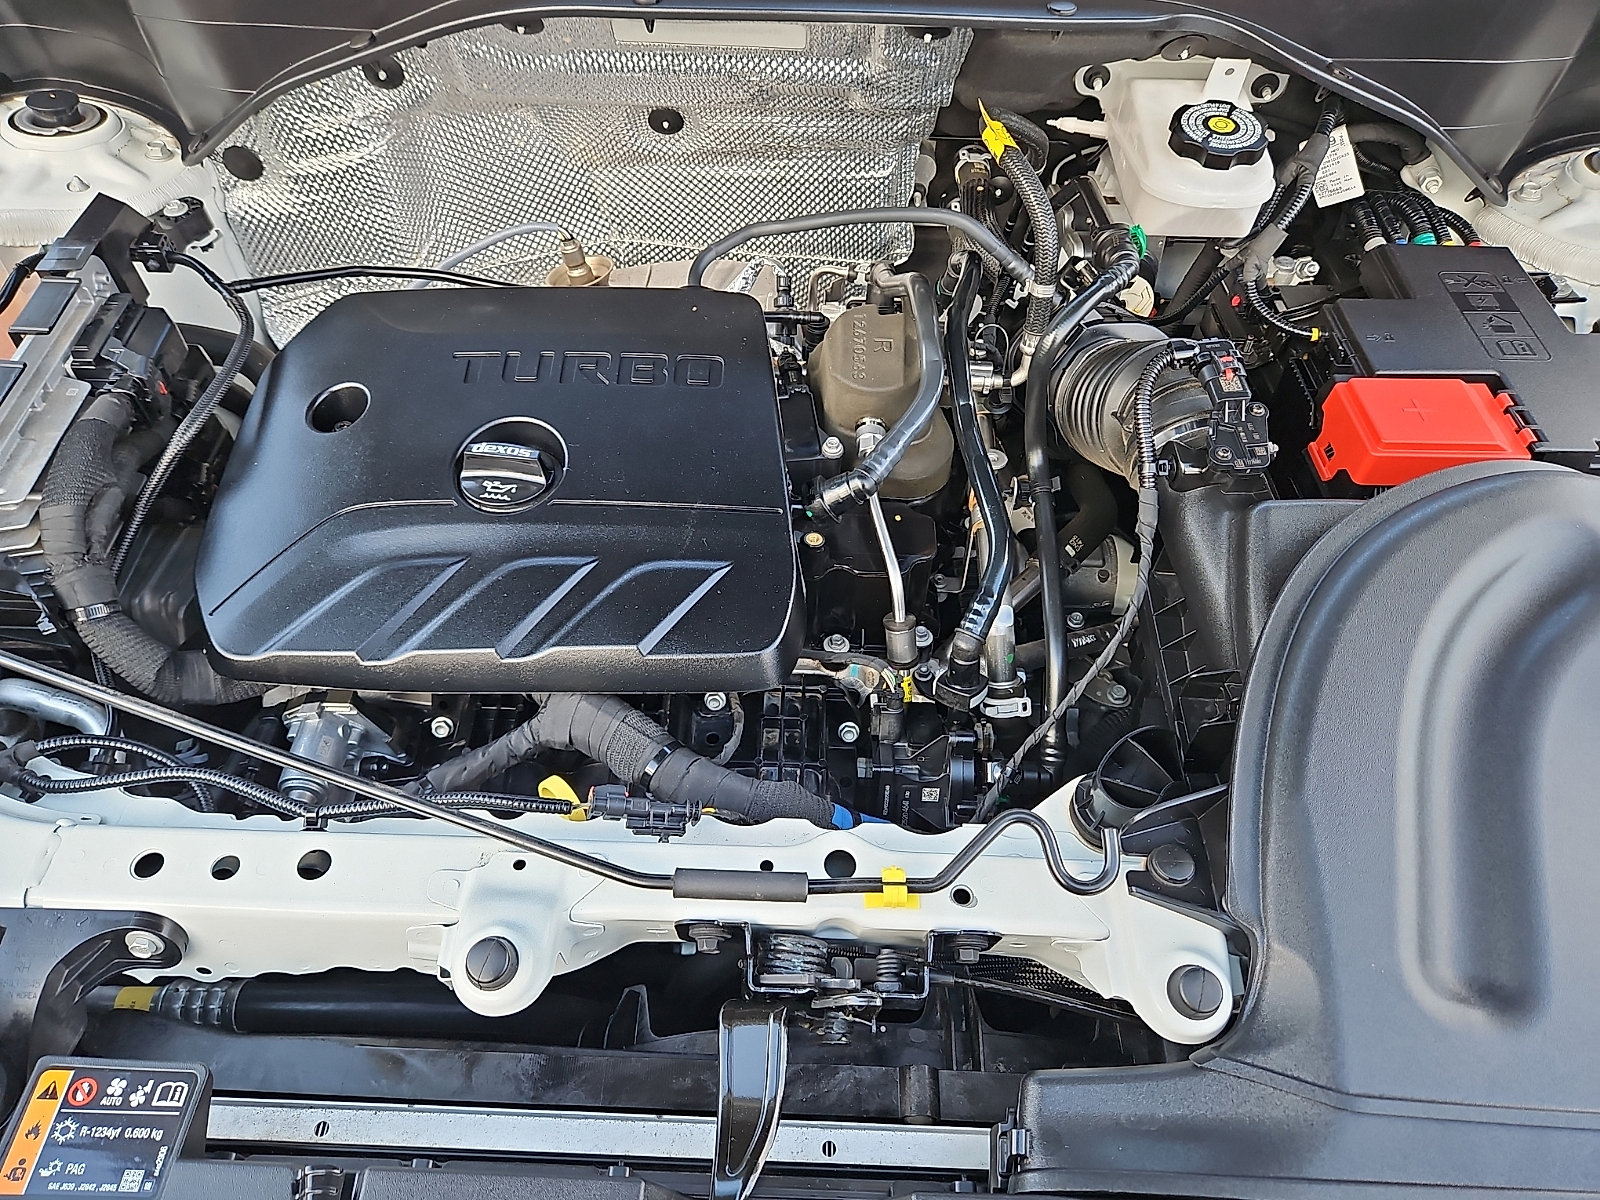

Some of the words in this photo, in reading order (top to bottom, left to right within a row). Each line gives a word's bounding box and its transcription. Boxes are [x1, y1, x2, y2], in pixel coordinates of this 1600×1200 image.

[873, 337, 894, 352] R
[452, 350, 726, 388] TURBO
[471, 442, 534, 458] dexos
[100, 1096, 123, 1107] AUTO
[79, 1126, 121, 1140] R-1234yf
[124, 1127, 150, 1139] 0.600
[151, 1127, 164, 1141] kg
[65, 1163, 86, 1176] PAG
[47, 1182, 60, 1190] SAE
